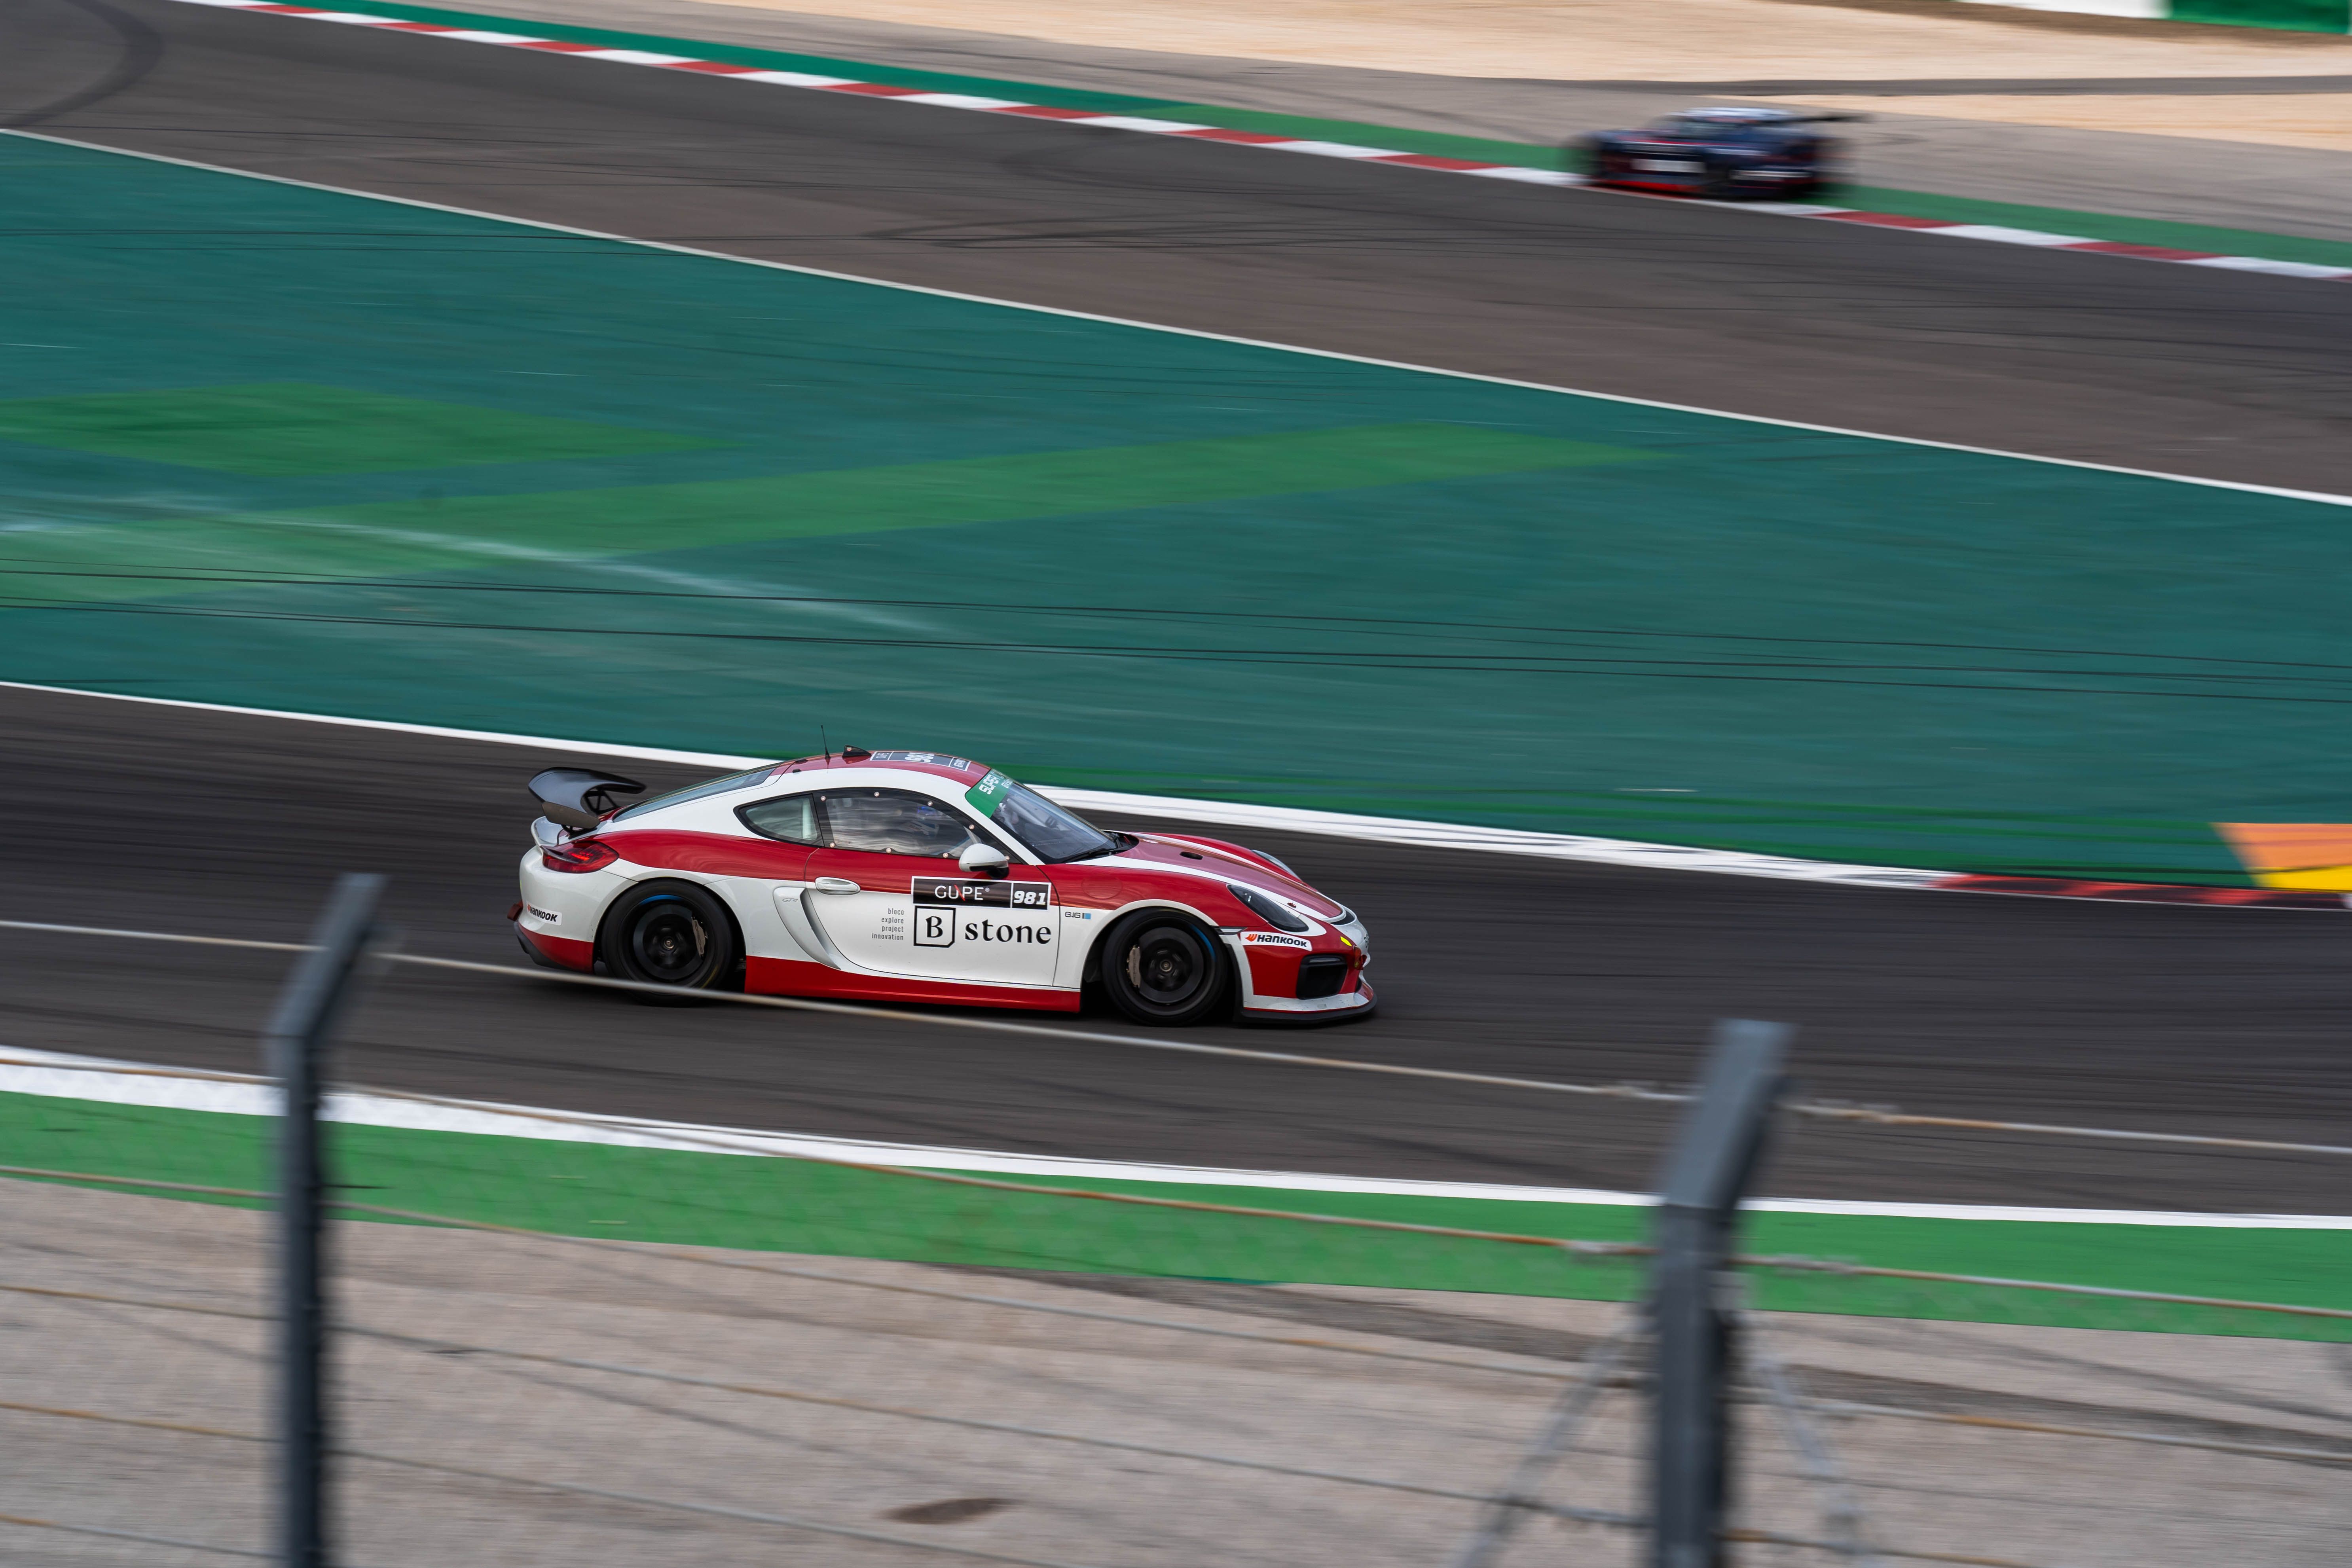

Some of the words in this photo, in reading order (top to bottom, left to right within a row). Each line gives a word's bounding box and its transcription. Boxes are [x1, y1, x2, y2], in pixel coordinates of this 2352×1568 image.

[1013, 891, 1046, 905] 981
[926, 916, 943, 938] B
[965, 919, 1051, 944] stone
